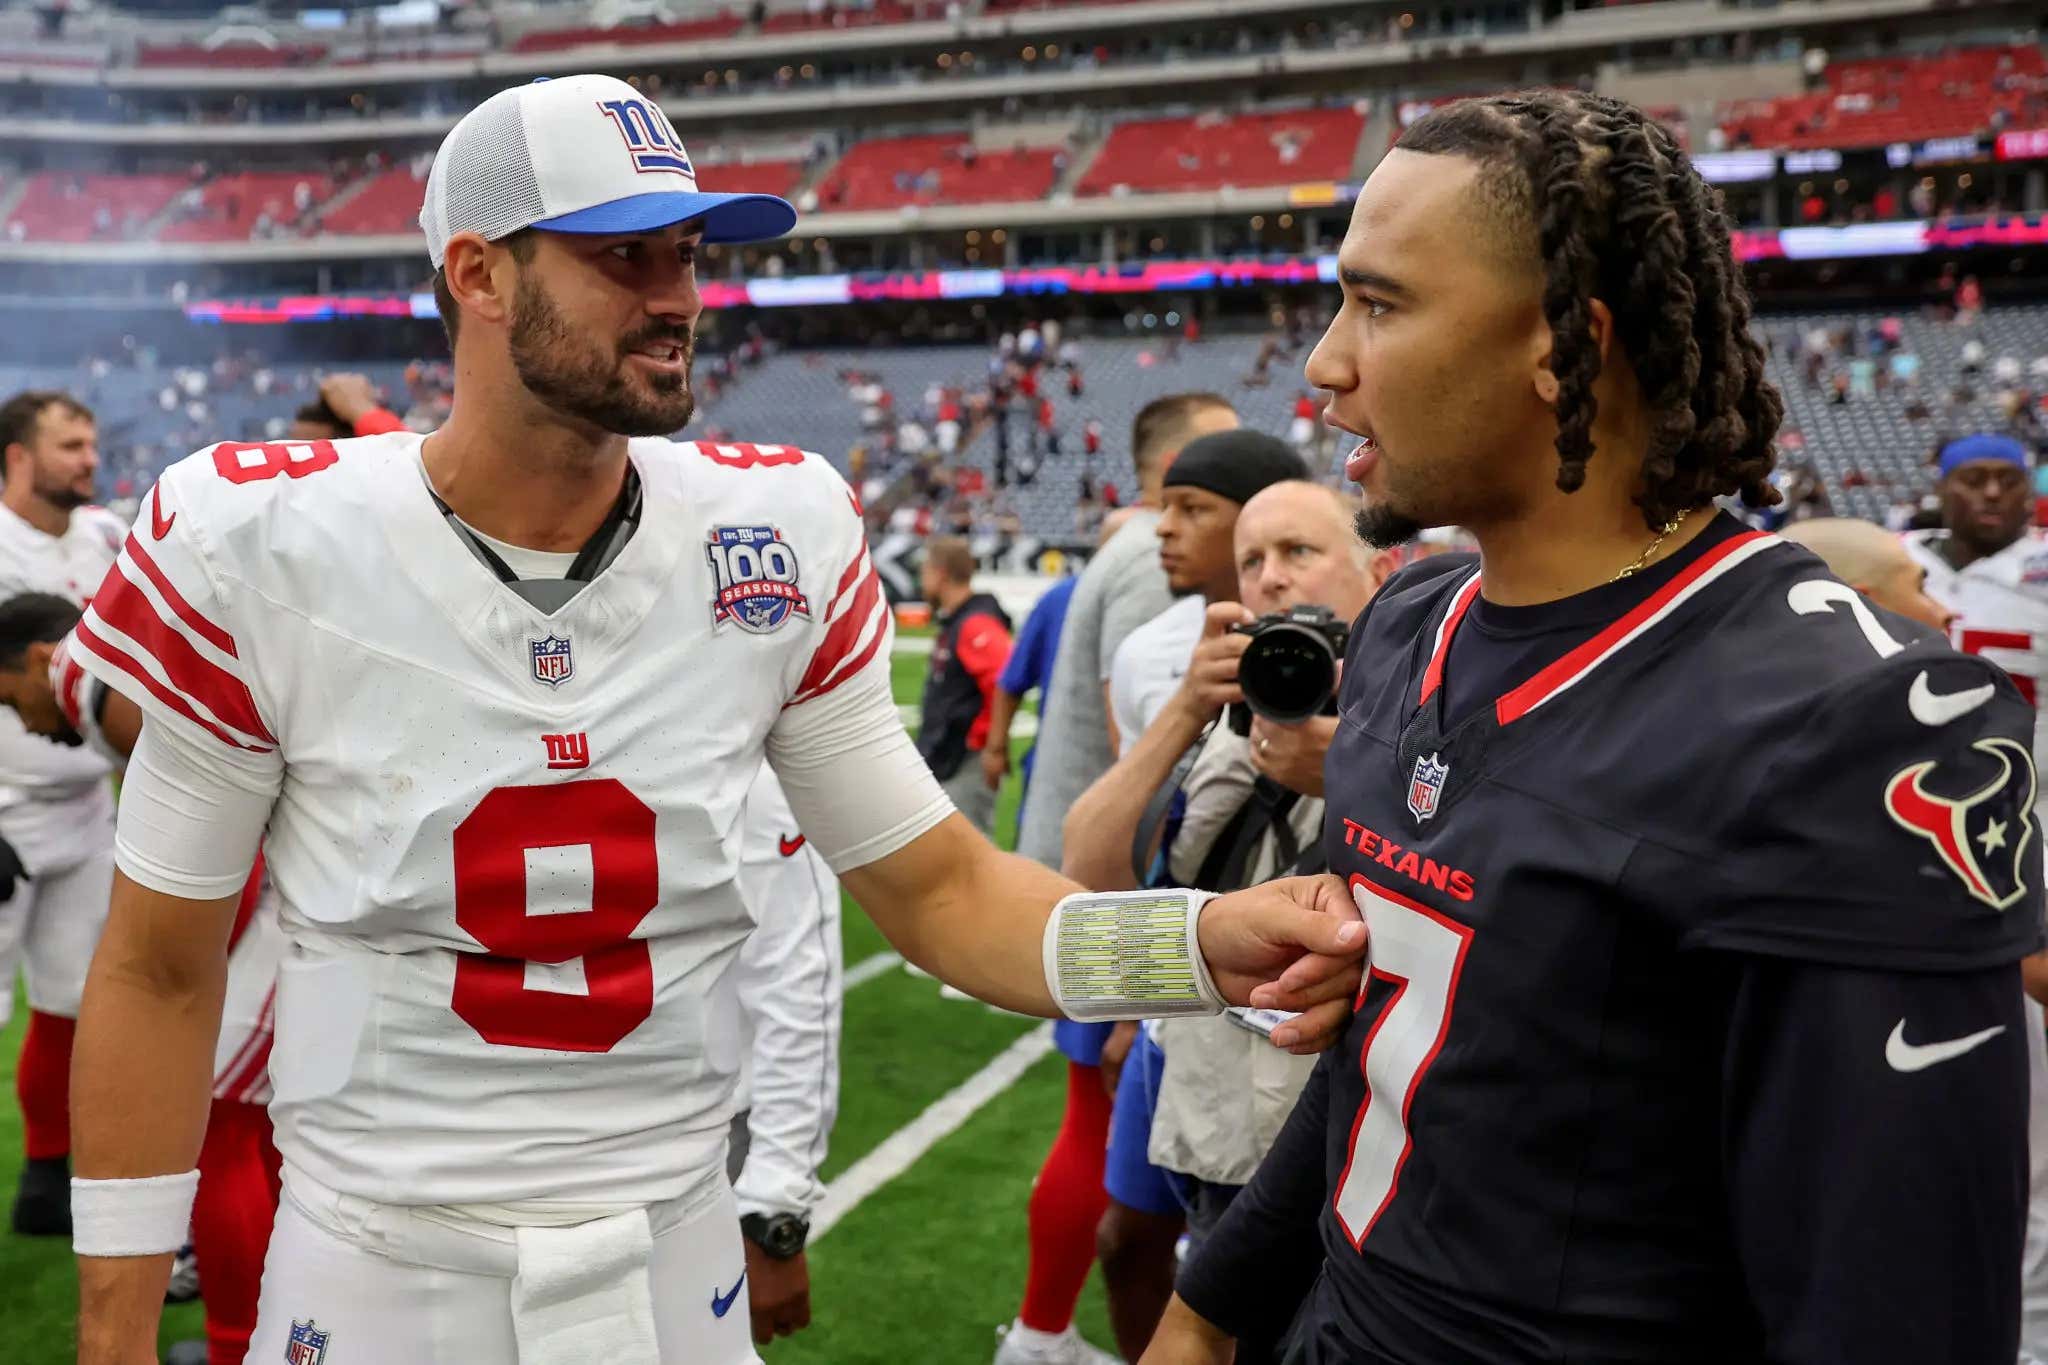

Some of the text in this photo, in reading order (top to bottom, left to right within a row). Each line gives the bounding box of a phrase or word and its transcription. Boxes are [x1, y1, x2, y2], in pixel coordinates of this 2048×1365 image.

[212, 439, 340, 485] 8
[711, 543, 797, 591] 100
[724, 583, 793, 602] SEASONS
[537, 655, 569, 679] NFL
[1411, 782, 1434, 811] NFL
[1343, 817, 1476, 902] TEXANS
[451, 778, 659, 1054] 8
[1334, 872, 1475, 1256] 7
[290, 1341, 316, 1365] NFL
